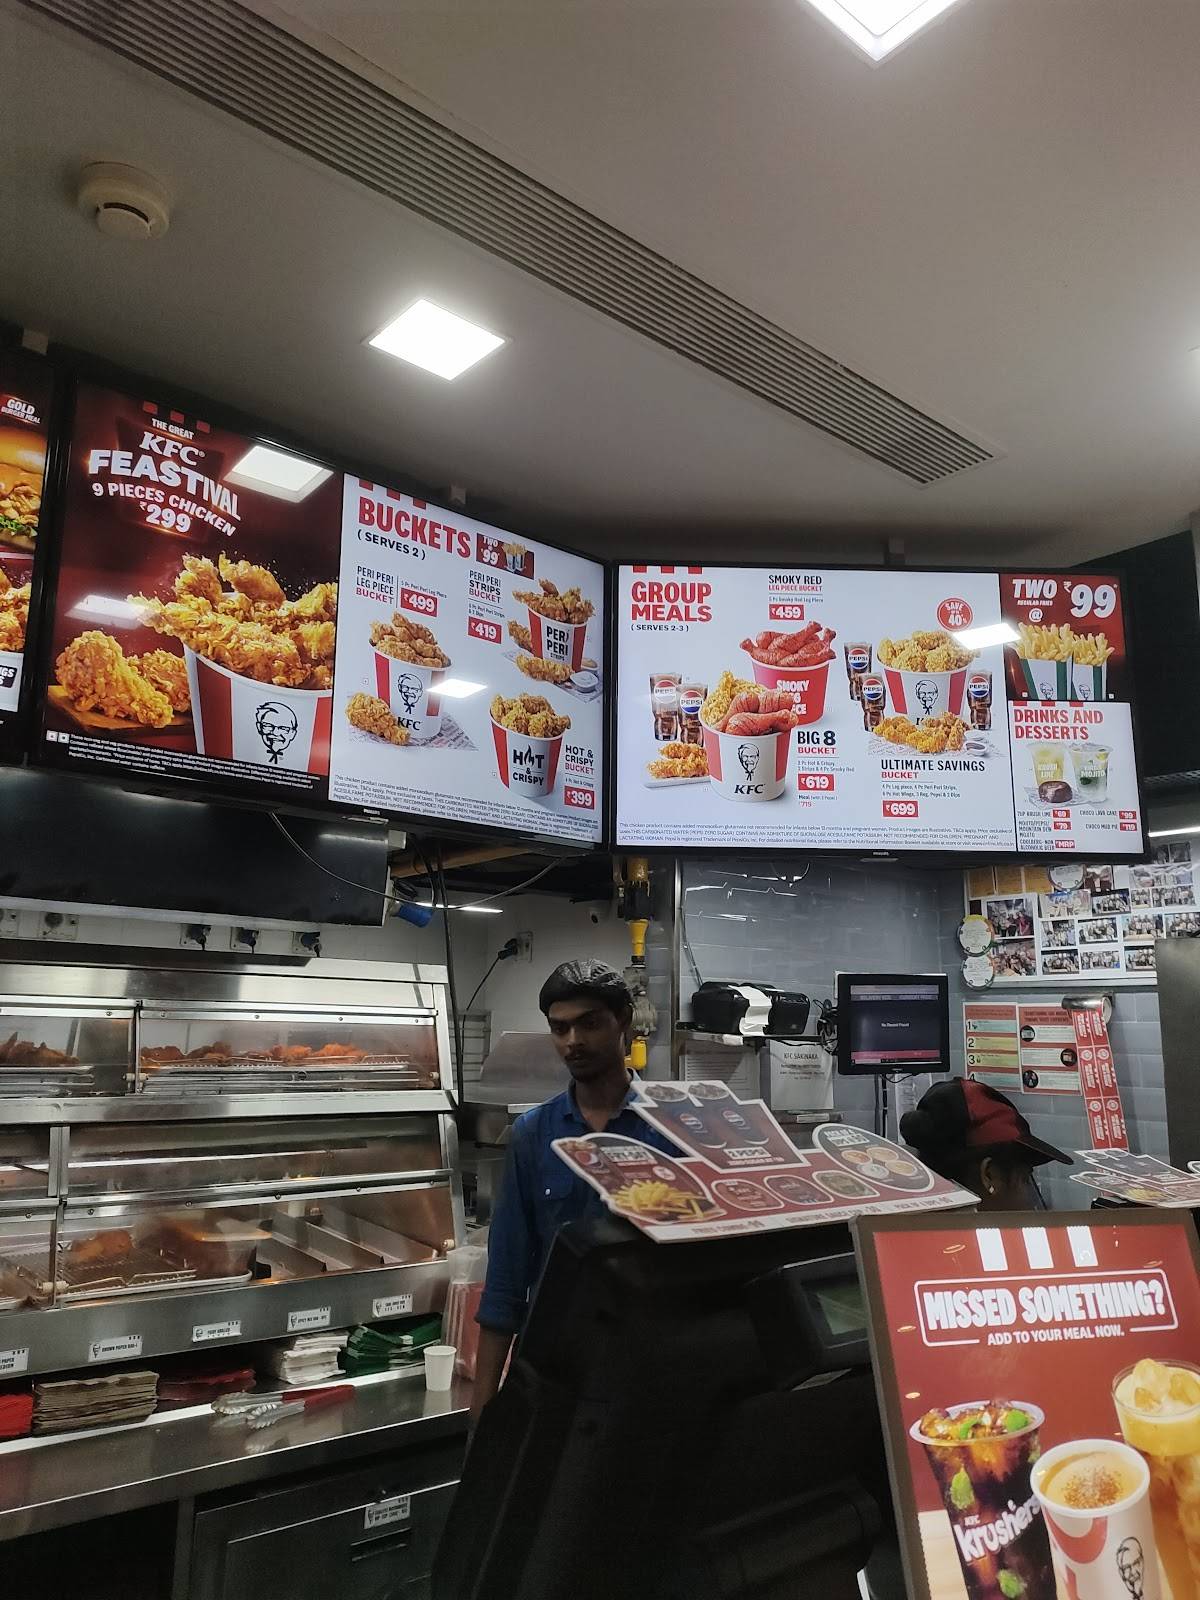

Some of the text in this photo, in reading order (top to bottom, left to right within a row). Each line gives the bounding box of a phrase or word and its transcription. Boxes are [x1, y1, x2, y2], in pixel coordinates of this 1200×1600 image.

[7, 399, 36, 415] GOLD
[1, 406, 41, 424] BURGER MEAL
[152, 418, 194, 439] THE GREAT
[88, 449, 241, 521] FEASTIVAL
[92, 482, 236, 537] 9 PIECES CHICKEN
[358, 496, 471, 558] BUCKETS
[483, 536, 498, 547] TWO
[357, 566, 394, 584] PERI PERI
[469, 570, 501, 587] PERI PERI
[768, 575, 822, 585] SMOKY RED
[357, 576, 394, 595] LEG PIECE
[469, 580, 501, 595] STRIPS
[631, 581, 712, 604] GROUP
[1012, 579, 1057, 599] TWO
[356, 587, 394, 604] BUCKET
[468, 588, 501, 603] BUCKET
[631, 604, 713, 622] MEALS
[945, 602, 964, 611] SAVE
[1029, 608, 1043, 622] @
[547, 626, 570, 642] PERI
[547, 639, 569, 656] PERI
[777, 680, 810, 692] SMOKY
[397, 717, 421, 731] KFC
[1014, 709, 1104, 724] DRINKS AND
[798, 730, 836, 746] BIG 8
[1015, 725, 1089, 740] DESSERTS
[565, 745, 594, 758] HOT &
[565, 755, 594, 767] CRISPY
[881, 760, 985, 771] ULTIMATE SAVINGS
[565, 763, 594, 775] BUCKET
[513, 772, 544, 786] CRISPY
[801, 776, 829, 788] ₹619
[734, 784, 764, 794] KFC
[886, 803, 915, 815] ₹699
[968, 1021, 971, 1030] 1
[968, 1038, 974, 1048] 2
[968, 1055, 975, 1065] 3
[923, 1279, 1165, 1330] MISSED SOMETHING?
[988, 1325, 1125, 1345] ADD TO YOUR MEAL NOW.
